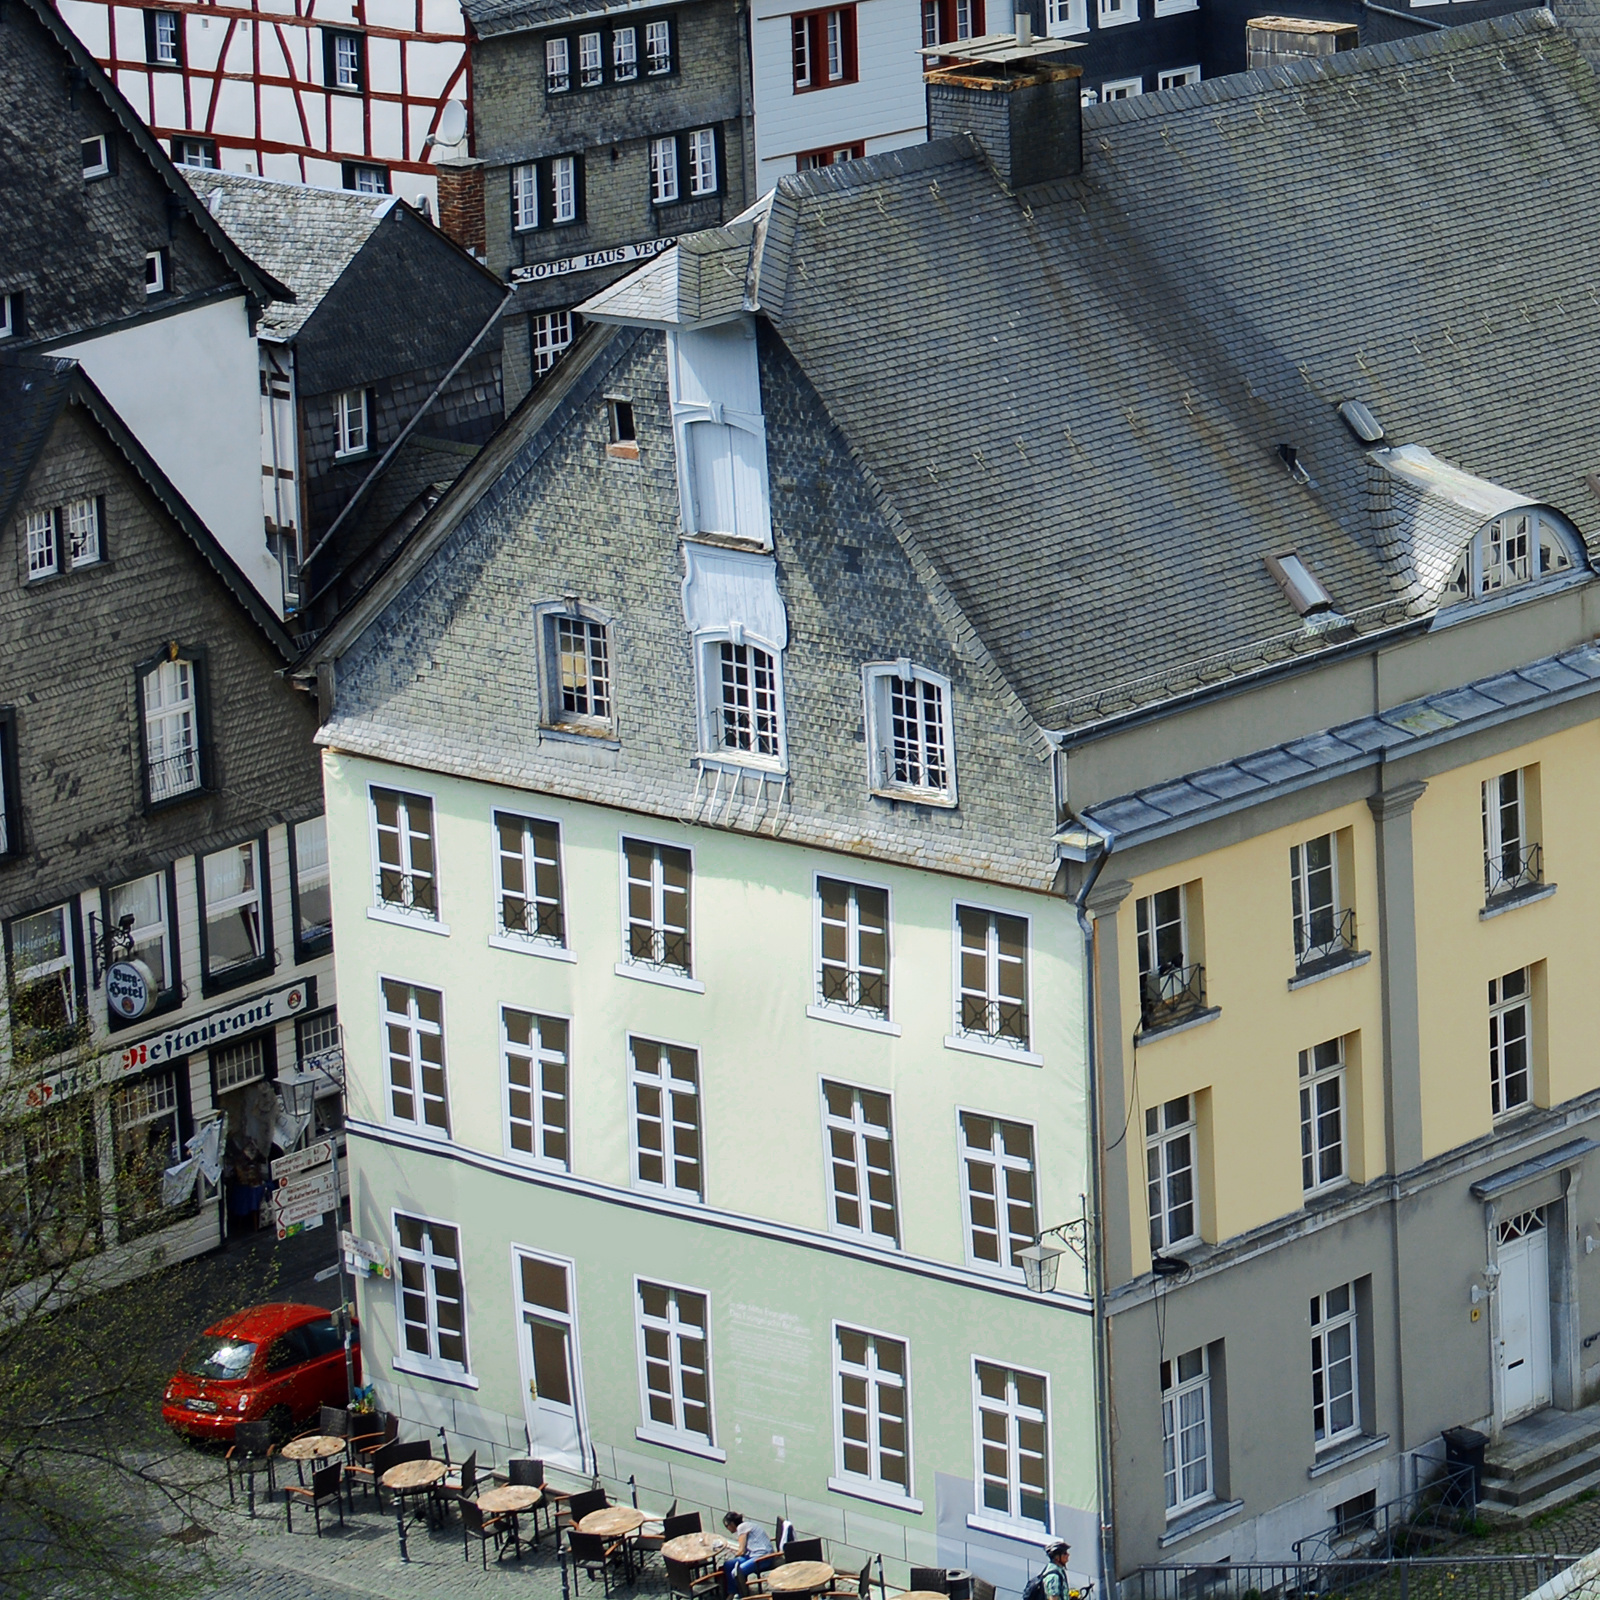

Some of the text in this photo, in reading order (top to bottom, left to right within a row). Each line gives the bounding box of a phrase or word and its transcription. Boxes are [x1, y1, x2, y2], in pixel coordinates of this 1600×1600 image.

[523, 259, 577, 279] HOTEL
[585, 248, 626, 267] HAUS
[112, 969, 141, 988] Burg-
[109, 982, 144, 1000] Hotel
